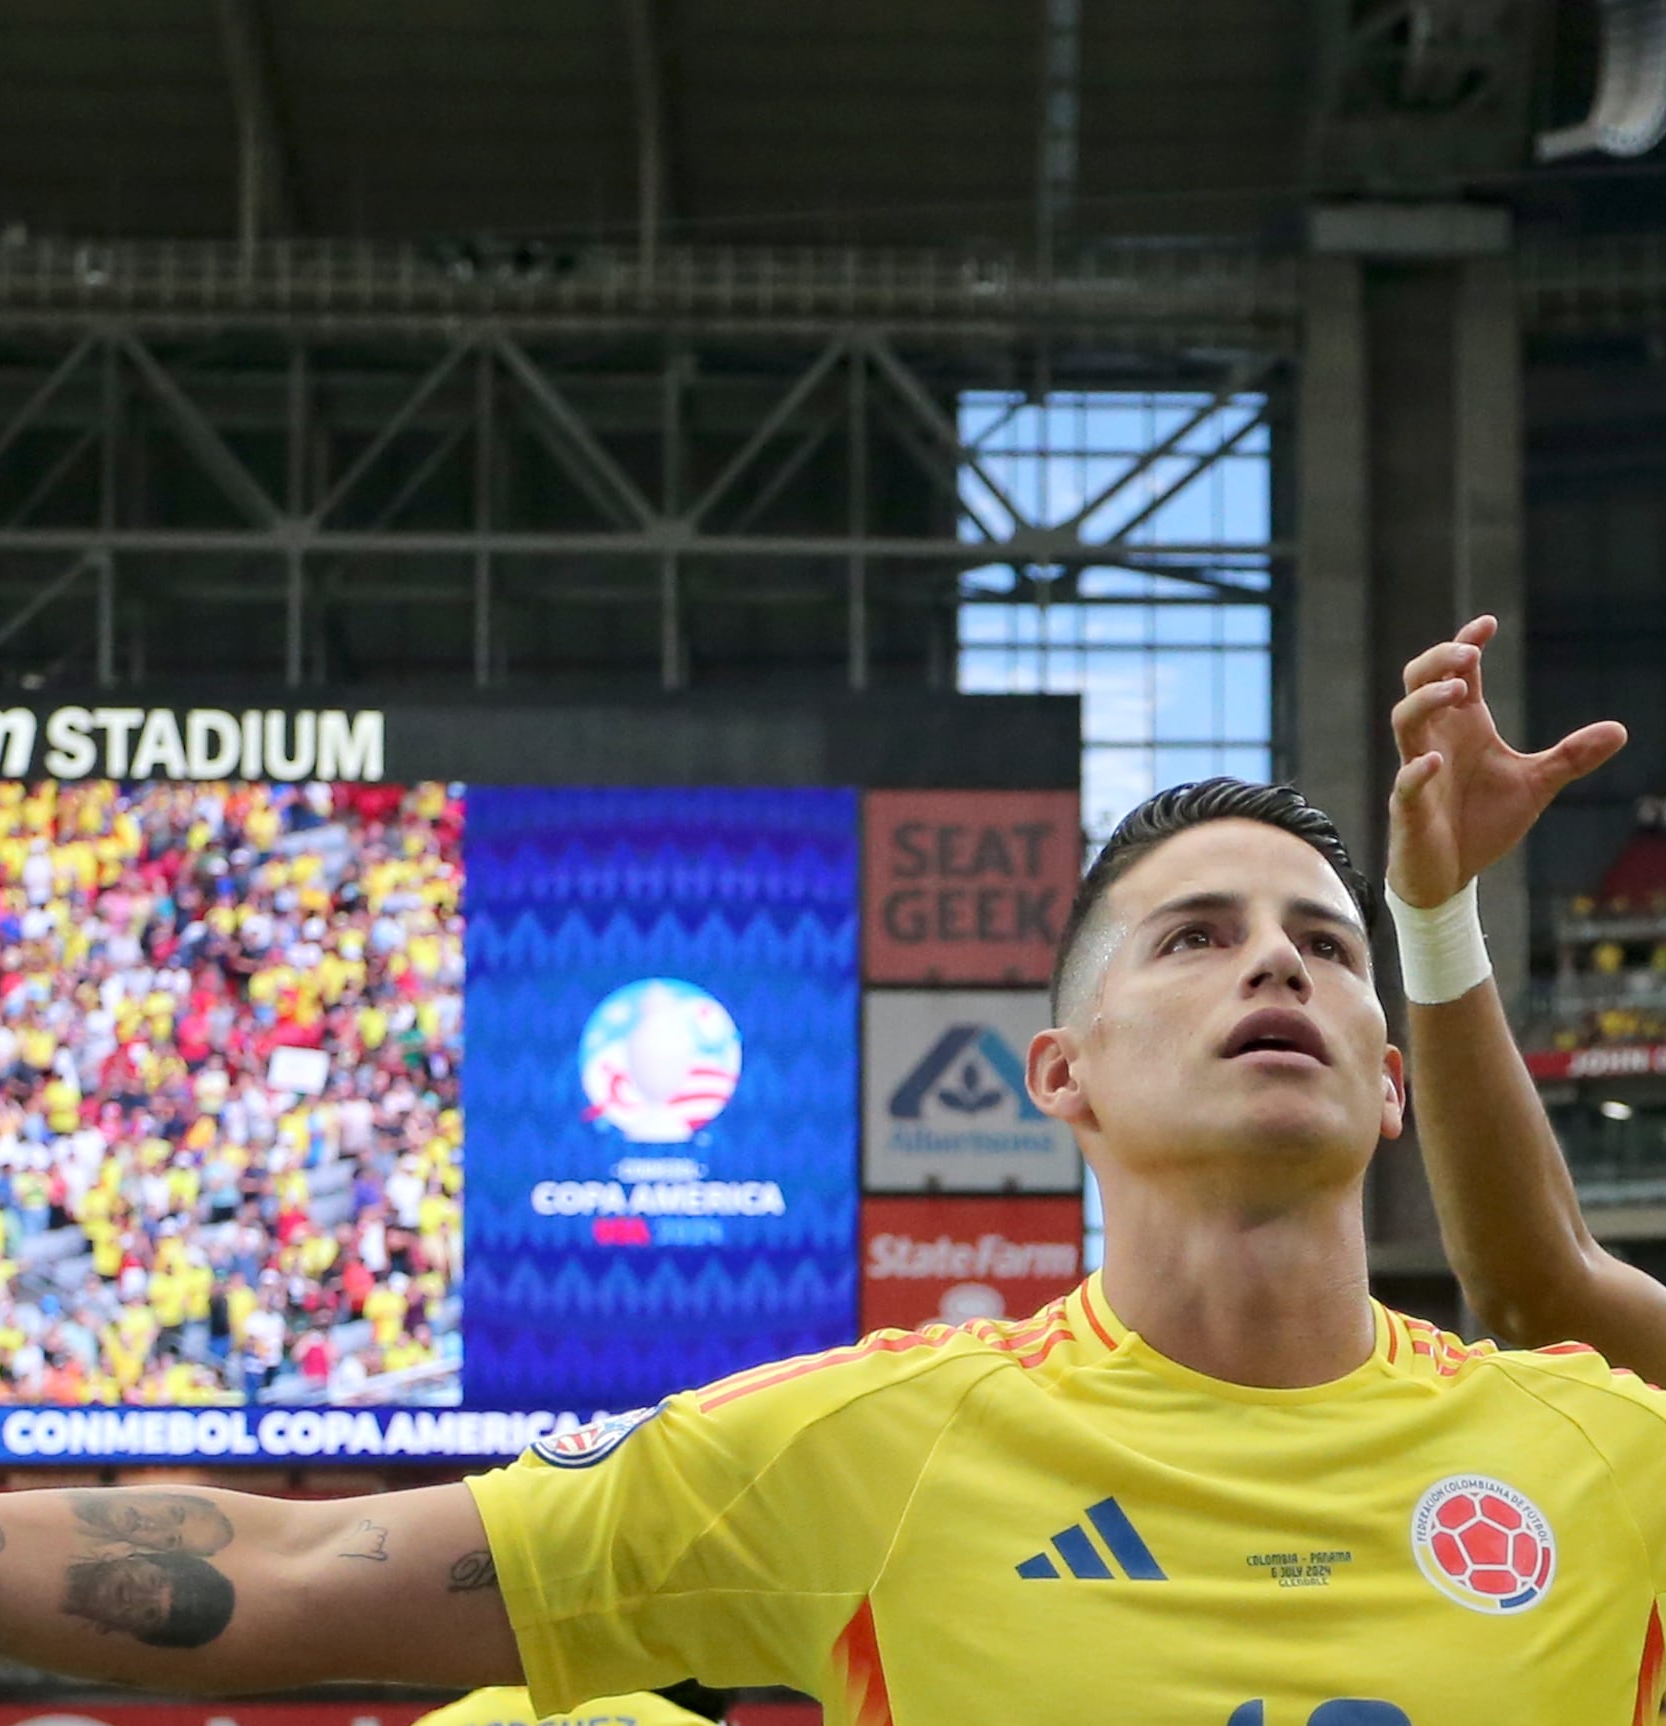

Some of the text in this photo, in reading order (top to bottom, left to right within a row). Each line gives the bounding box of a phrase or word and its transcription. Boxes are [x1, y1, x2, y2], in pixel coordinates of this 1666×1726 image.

[44, 708, 383, 783] STADIUM
[893, 821, 1055, 880] SEAT
[884, 886, 1062, 945] GEEK
[2, 1409, 258, 1455] CONMEBOL
[258, 1409, 382, 1455] COPA
[1443, 1479, 1510, 1499] COLOMBIANA
[1510, 1494, 1525, 1509] DE
[1245, 1553, 1298, 1567] COLOMBIA
[1310, 1551, 1352, 1564] PANAMA
[1279, 1566, 1304, 1579] JULY
